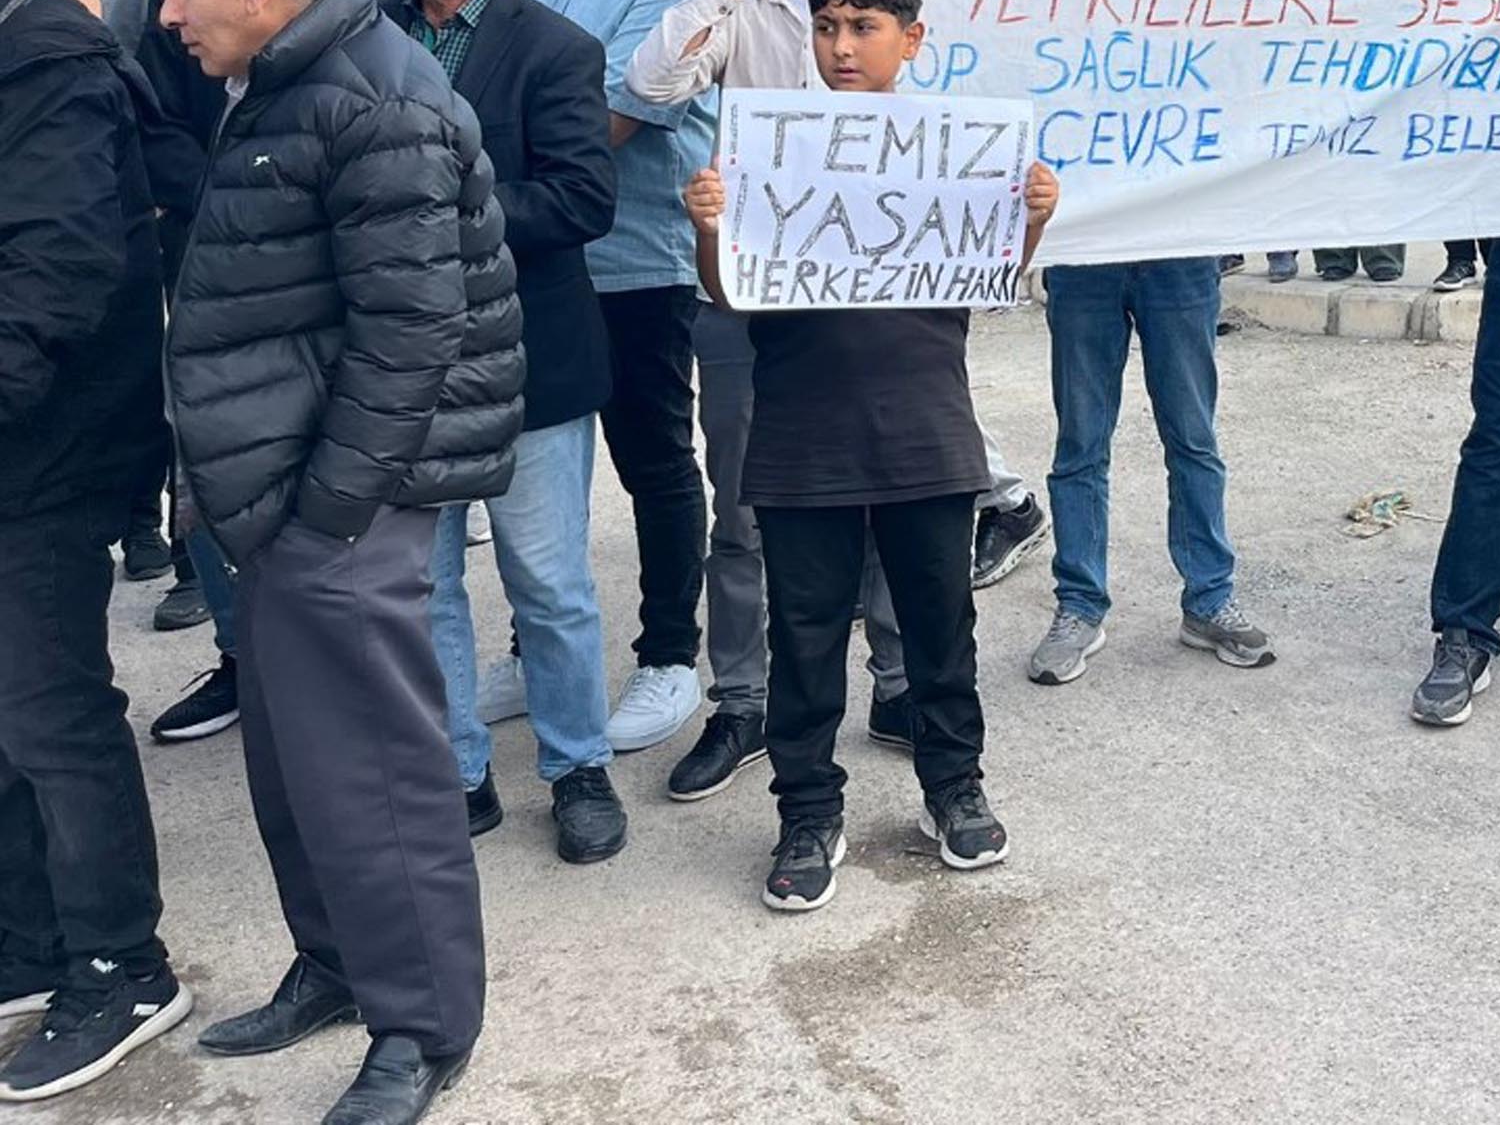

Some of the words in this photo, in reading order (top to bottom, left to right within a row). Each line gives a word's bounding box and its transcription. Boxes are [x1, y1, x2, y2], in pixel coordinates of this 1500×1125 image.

[898, 26, 978, 91] ÖP
[1031, 31, 1217, 94] SAĞLIK
[1037, 104, 1223, 171] ÇEVRE
